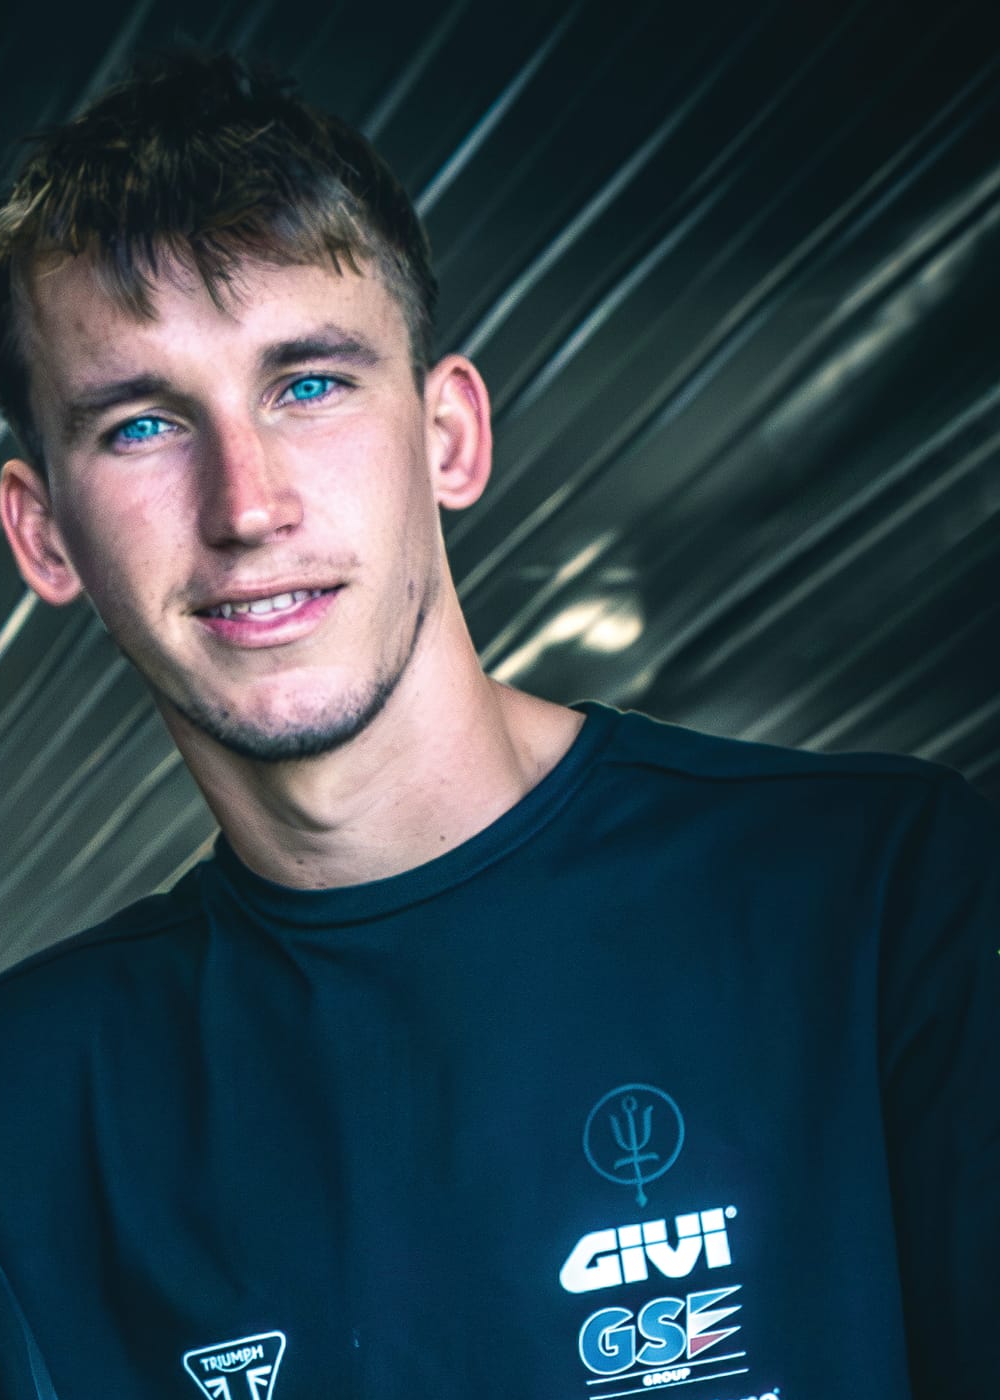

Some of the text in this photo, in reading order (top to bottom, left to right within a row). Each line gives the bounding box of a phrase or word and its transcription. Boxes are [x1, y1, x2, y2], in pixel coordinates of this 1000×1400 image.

[559, 1207, 732, 1294] GIVI
[200, 1344, 265, 1373] TRIUMPH
[642, 1367, 691, 1387] GROUP
